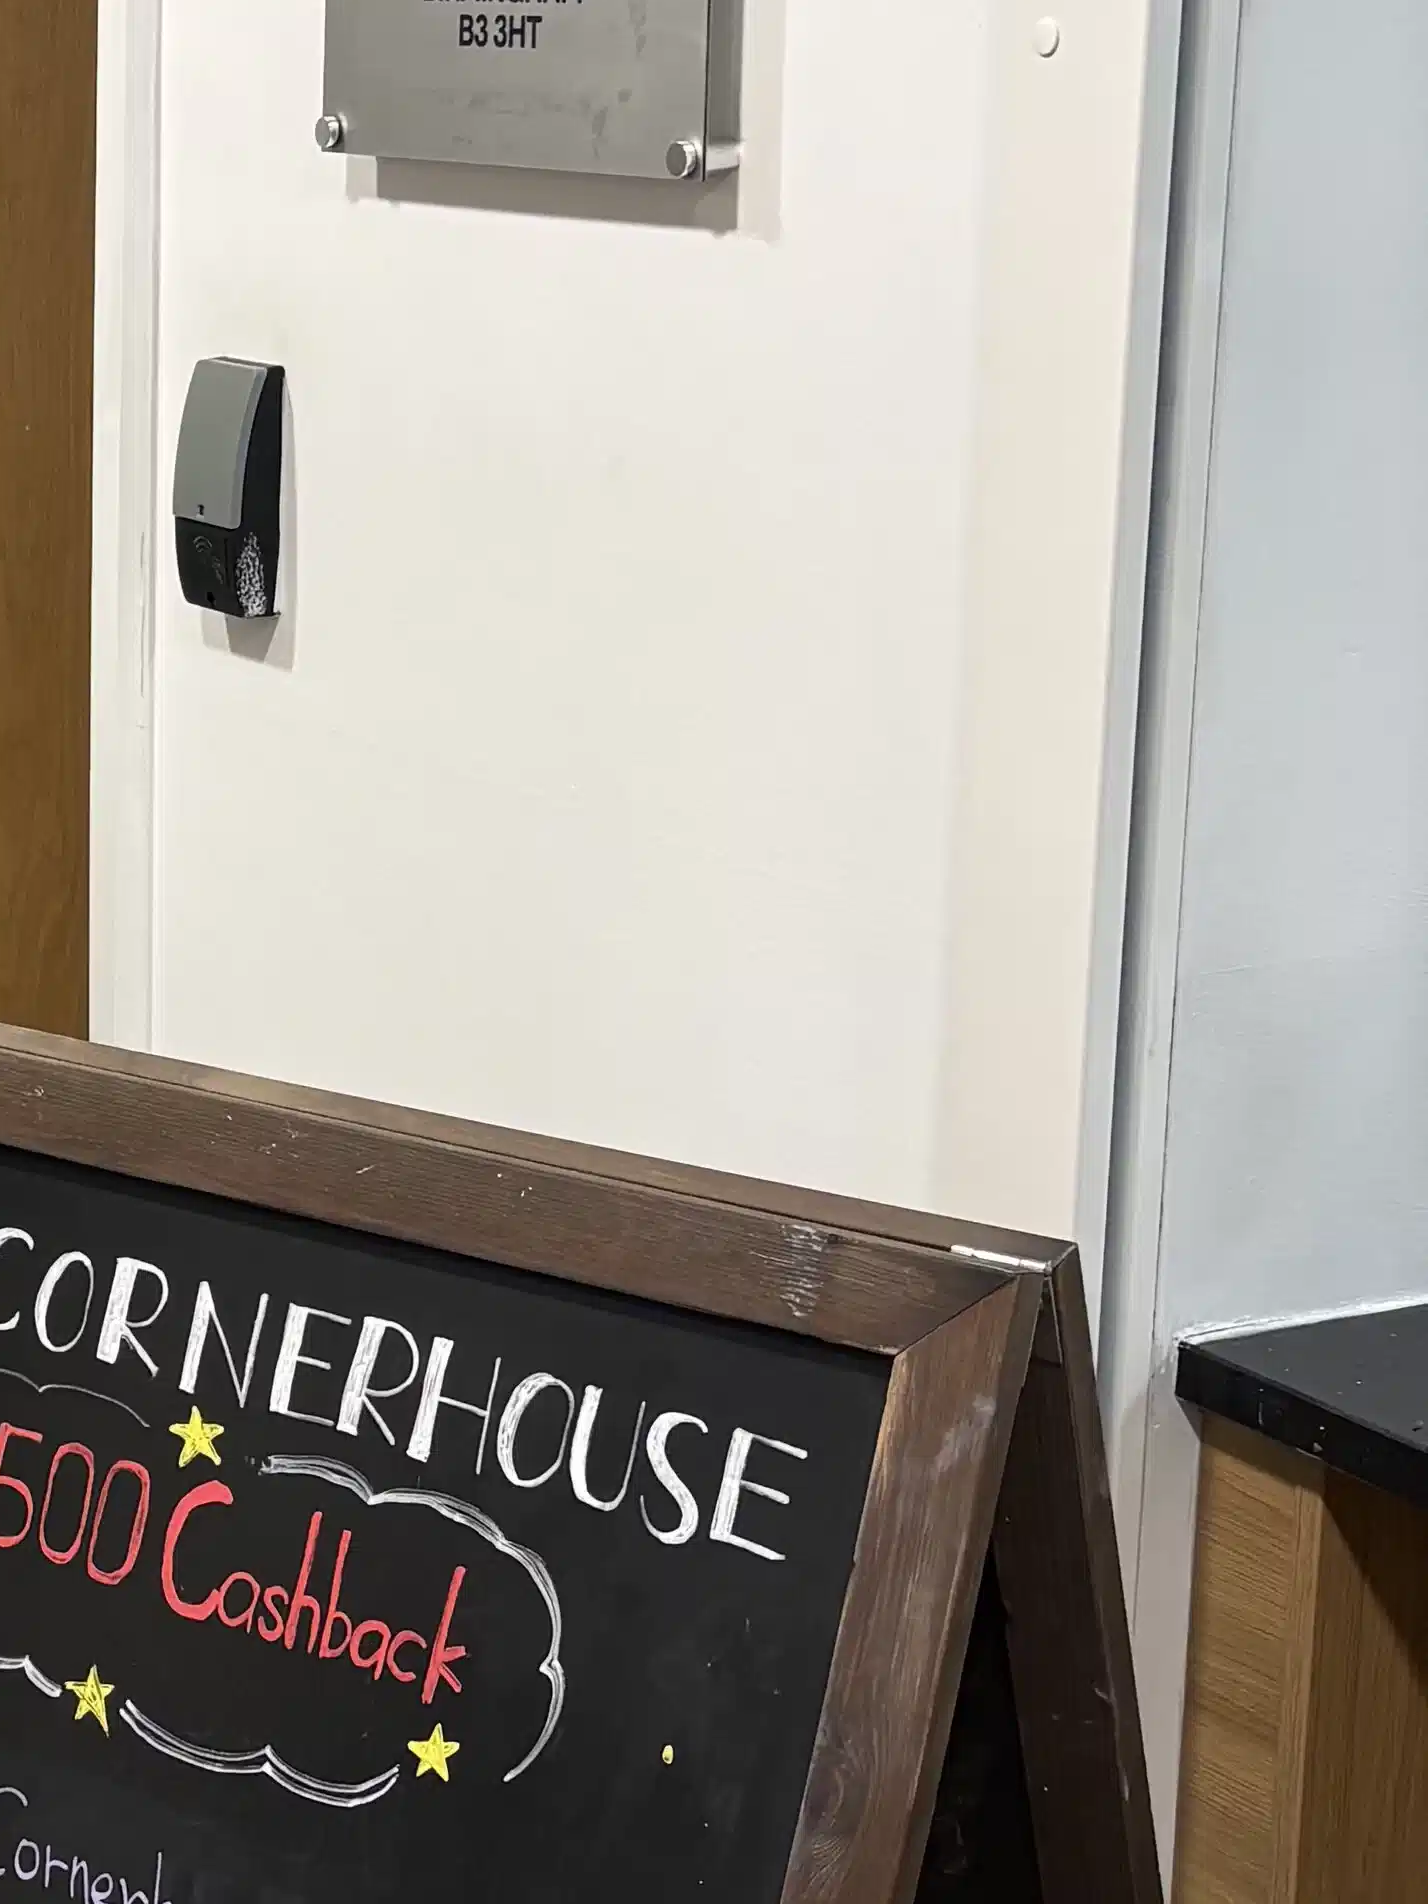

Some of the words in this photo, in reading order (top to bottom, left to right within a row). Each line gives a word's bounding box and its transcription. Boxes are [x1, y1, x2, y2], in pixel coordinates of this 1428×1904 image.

[459, 13, 488, 48] B3
[493, 13, 543, 49] 3HT
[159, 1478, 470, 1705] Cashback
